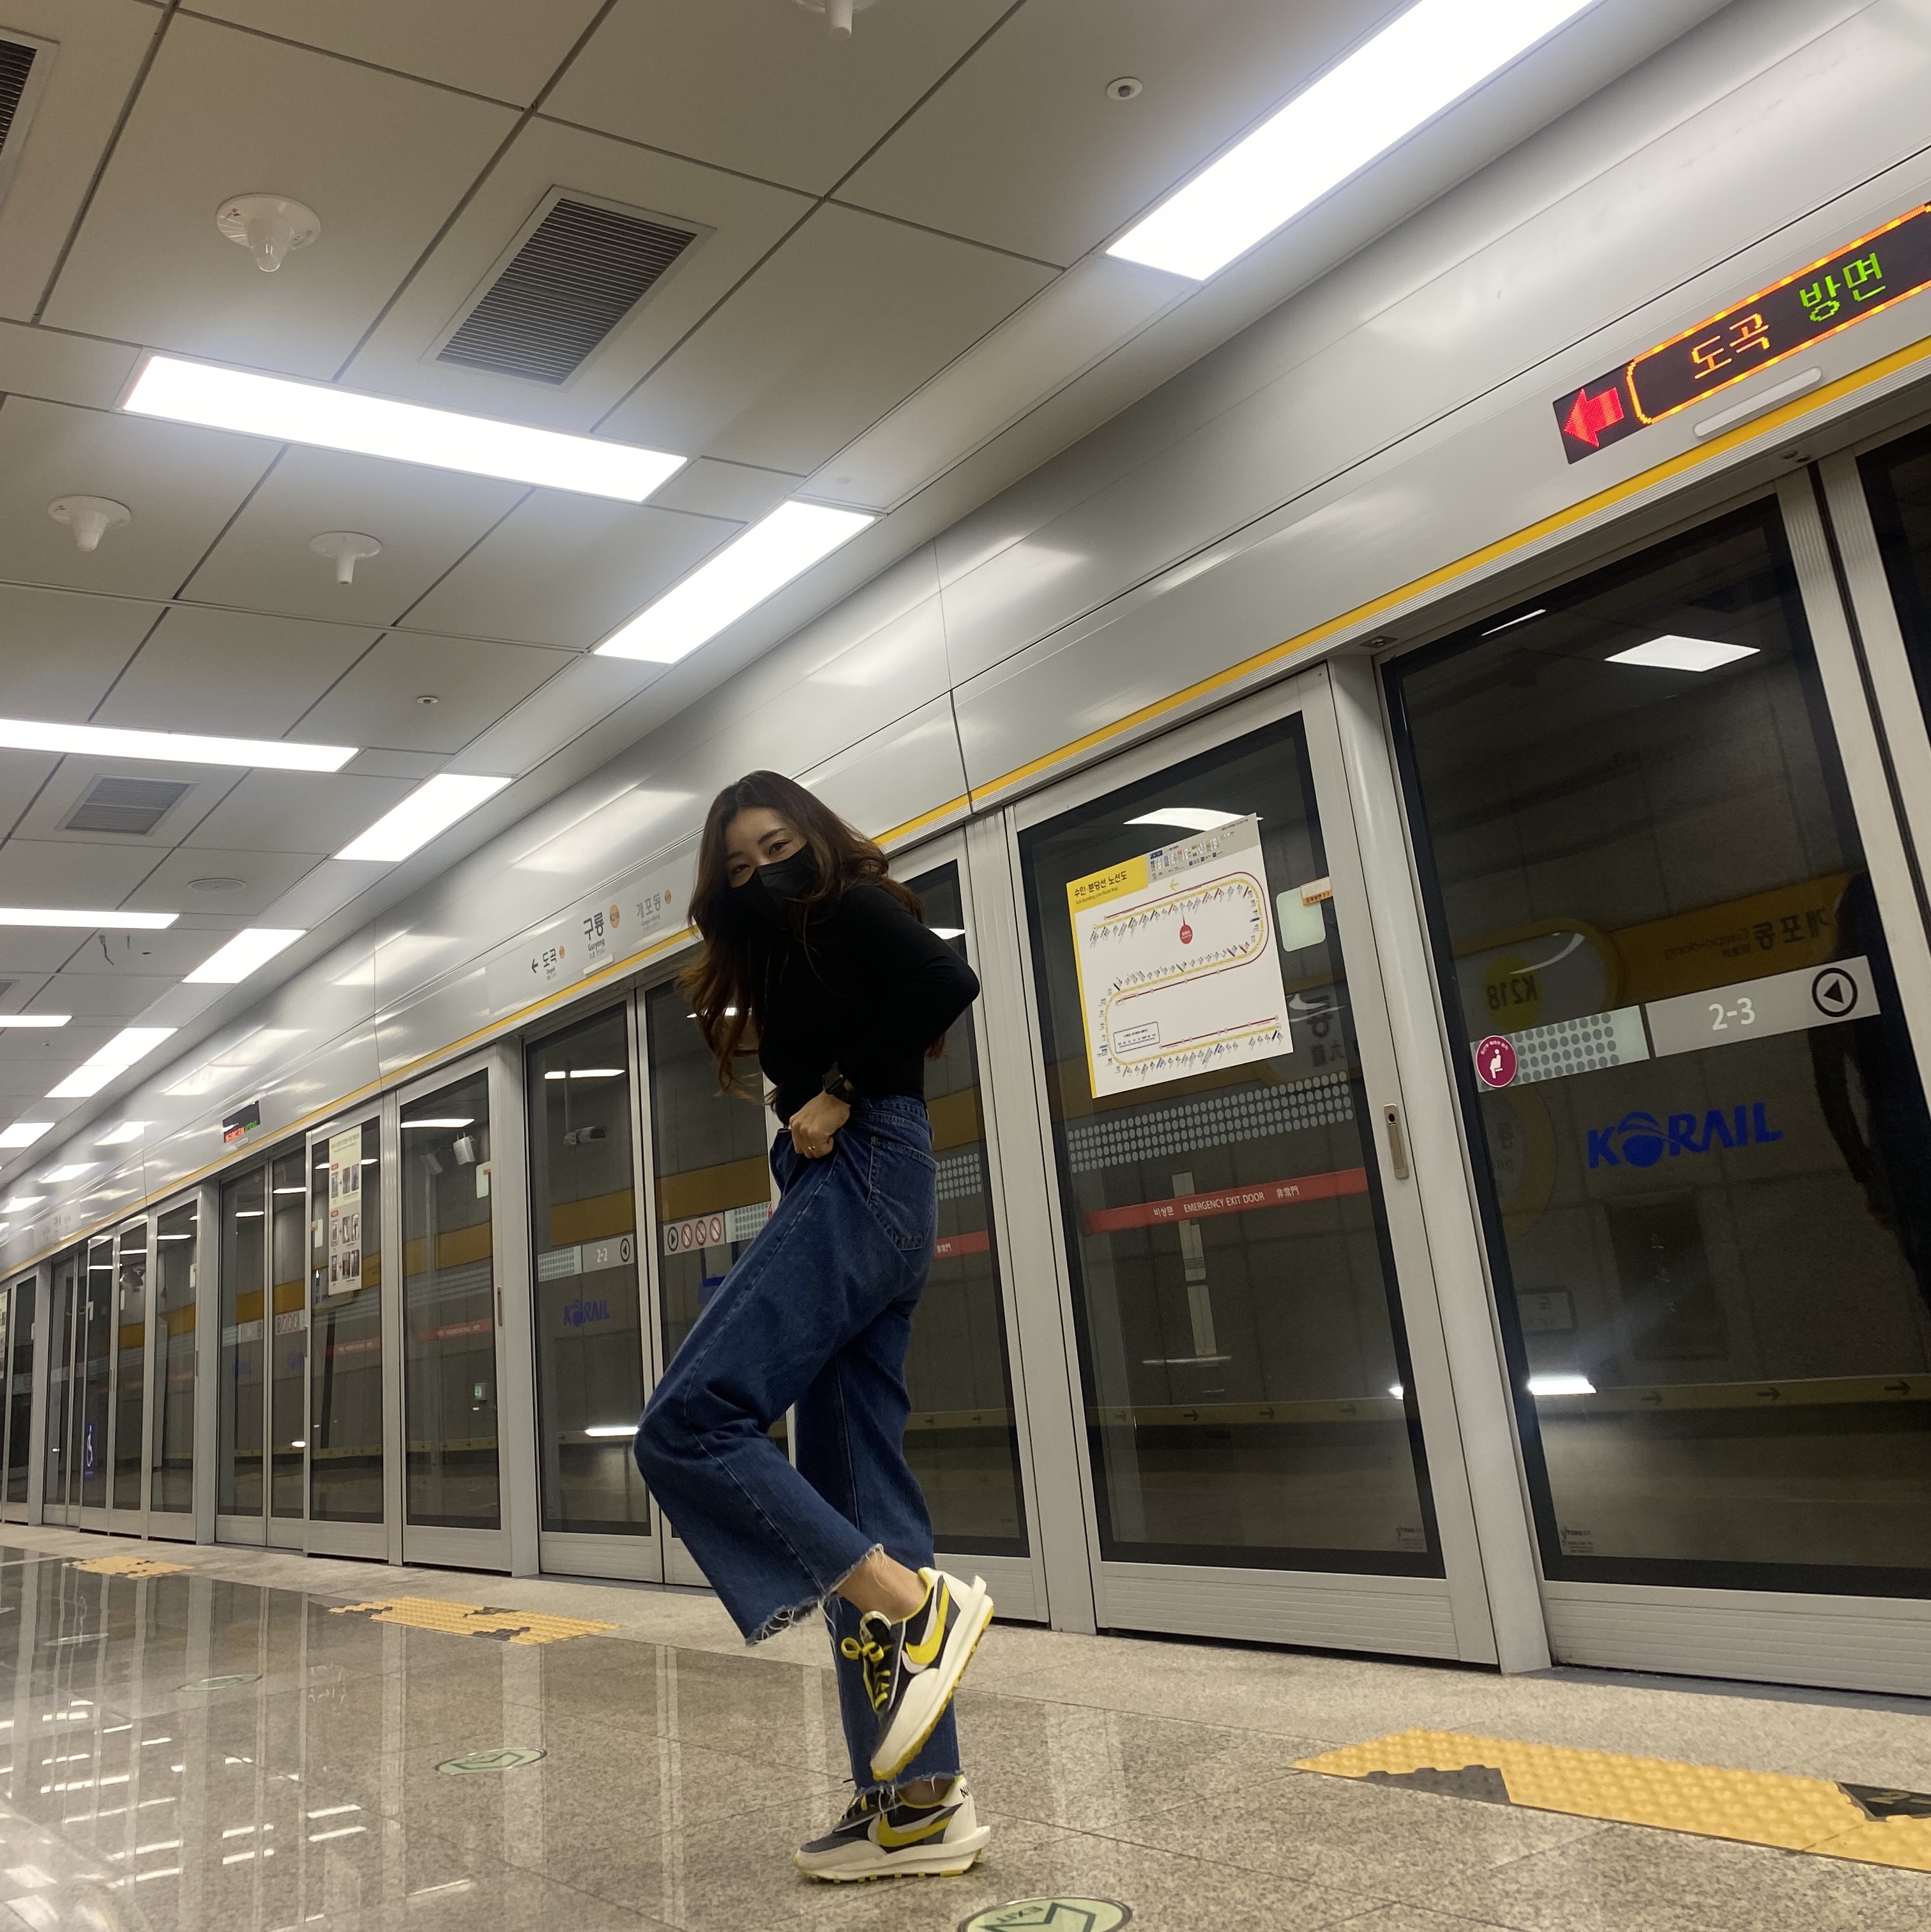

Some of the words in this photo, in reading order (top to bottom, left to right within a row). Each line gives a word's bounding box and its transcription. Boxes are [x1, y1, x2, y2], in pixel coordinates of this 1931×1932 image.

[1690, 312, 1771, 379] 도곡
[1799, 252, 1887, 323] 방면
[1108, 871, 1128, 885] 노선도
[635, 893, 662, 918] 개포동
[583, 911, 604, 941] 구룡
[587, 939, 605, 952] Guryong
[542, 948, 557, 968] 도곡
[1708, 998, 1755, 1030] 2-3
[1587, 1101, 1783, 1169] KORAIL
[1153, 1206, 1174, 1217] 비상문
[1183, 1198, 1225, 1213] EMERGENCY
[1225, 1195, 1241, 1208] EXIT
[1243, 1192, 1265, 1205] DOOR
[596, 1247, 608, 1263] 2-2
